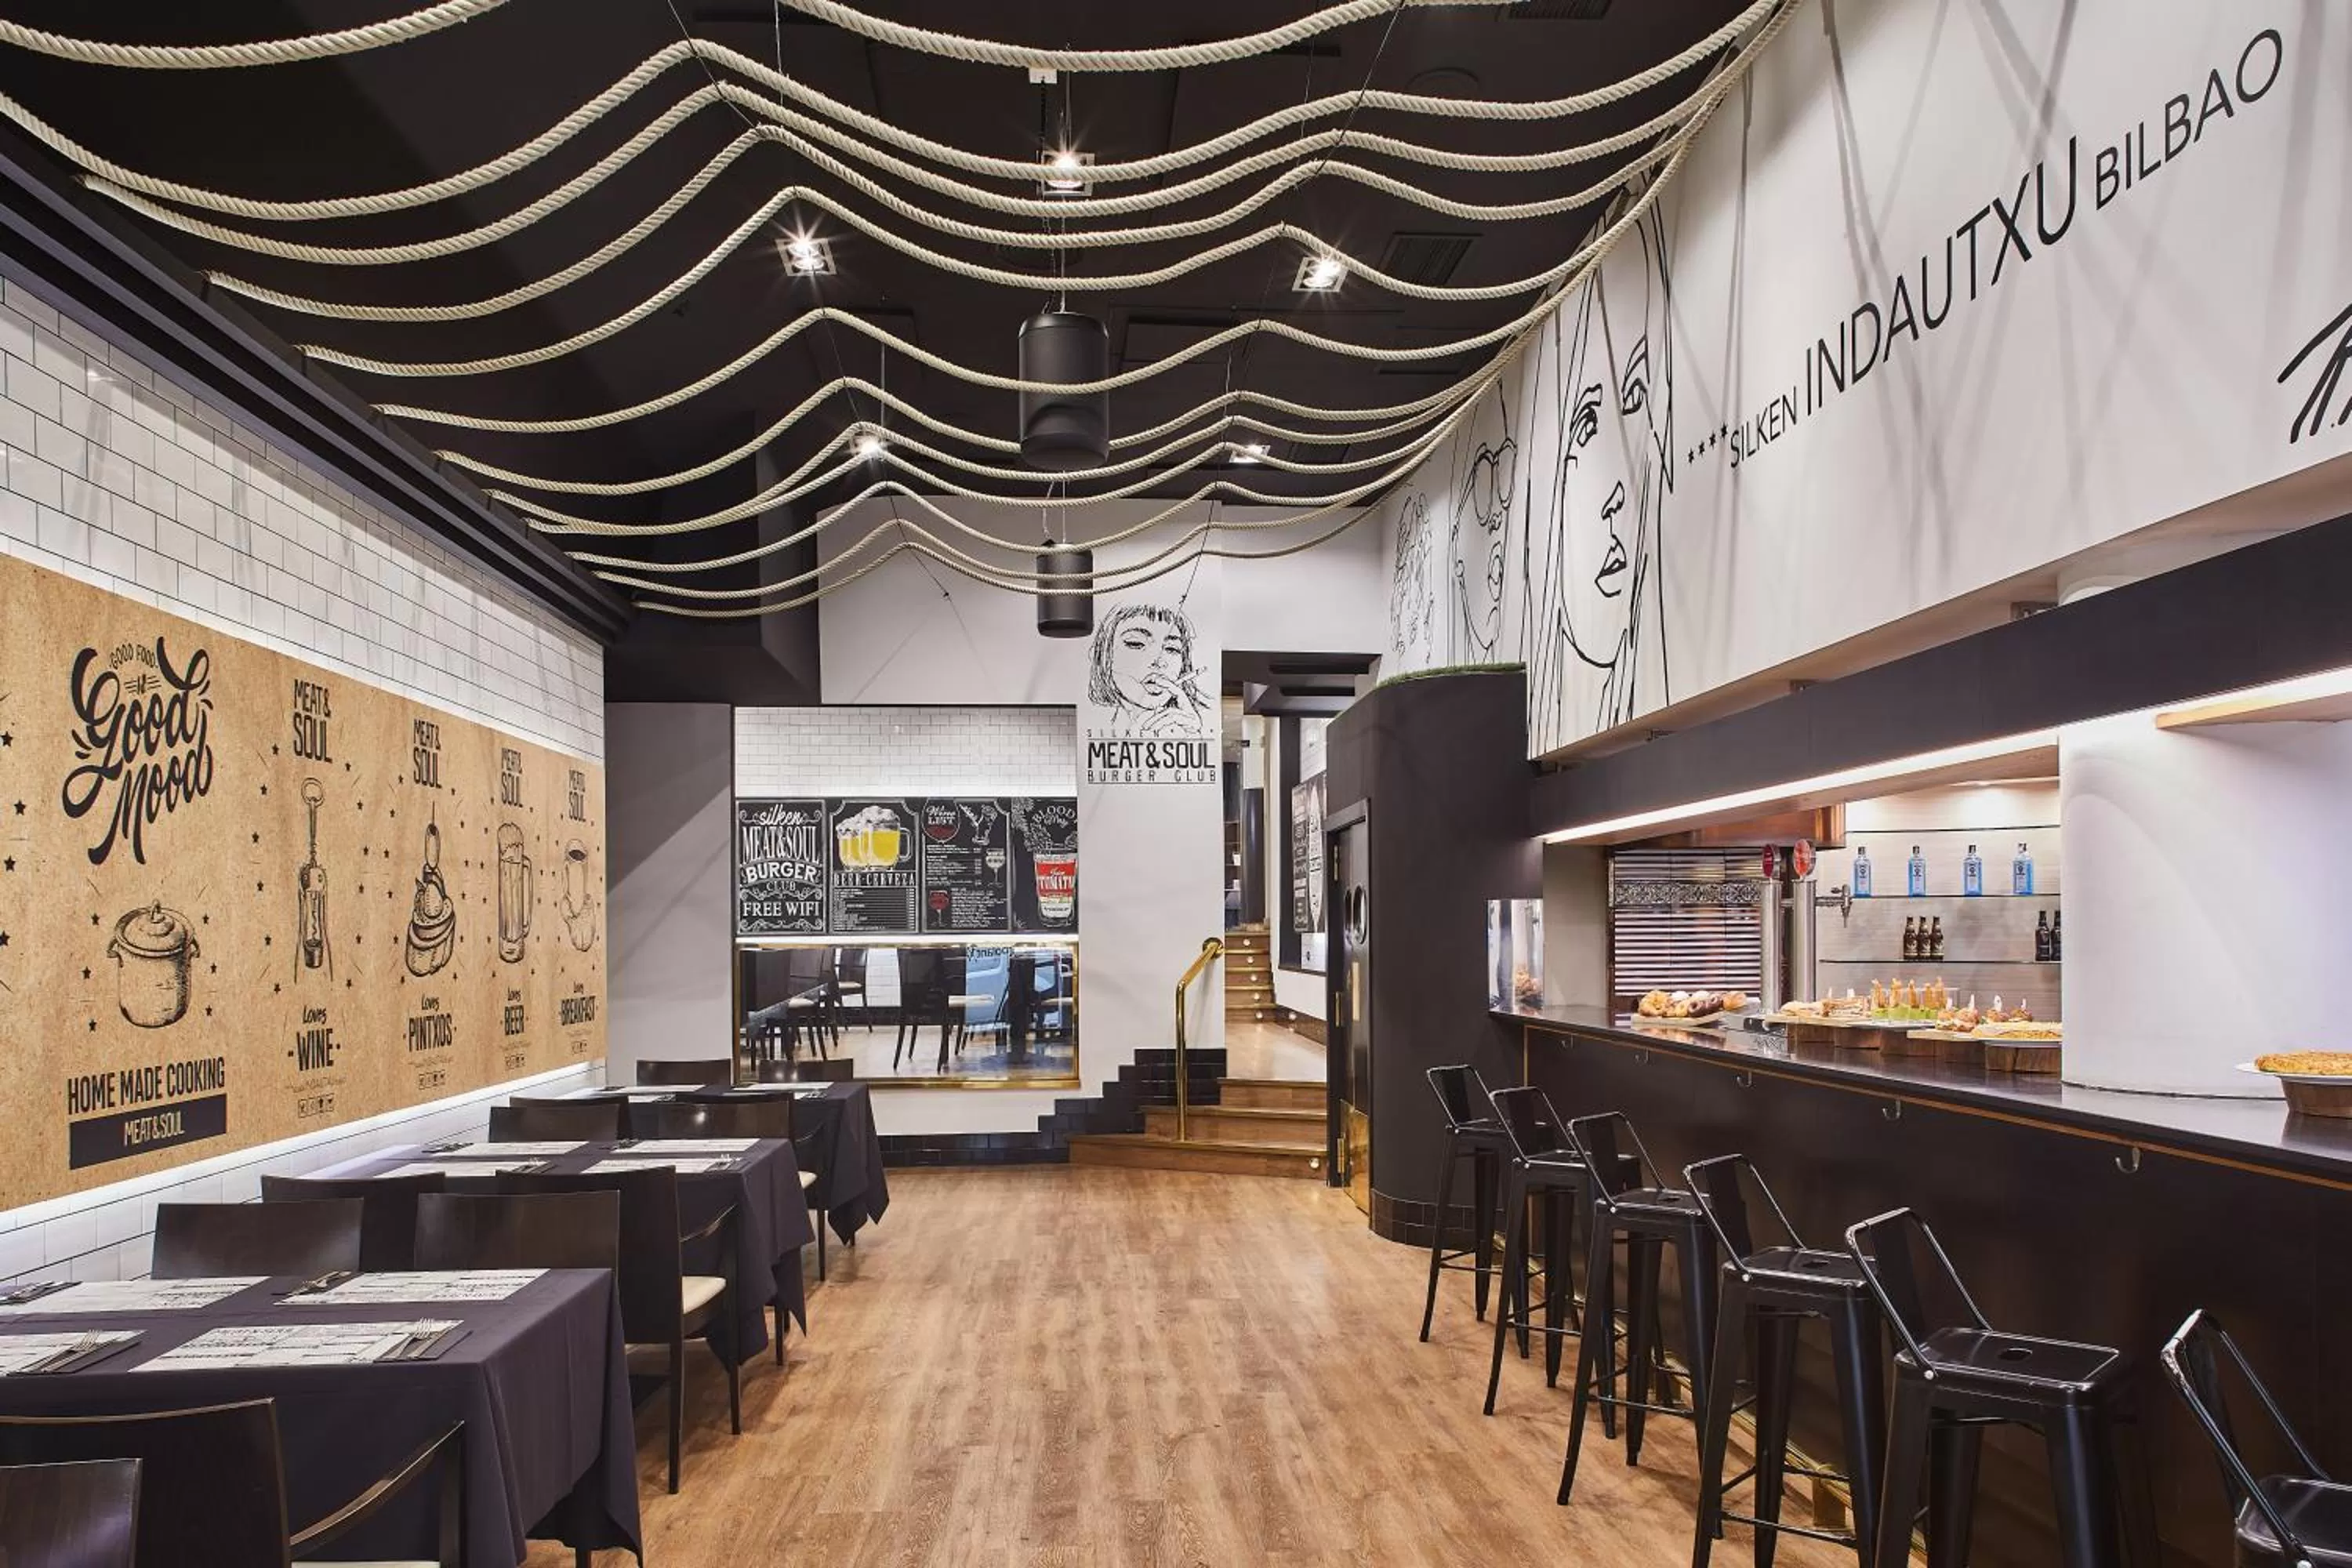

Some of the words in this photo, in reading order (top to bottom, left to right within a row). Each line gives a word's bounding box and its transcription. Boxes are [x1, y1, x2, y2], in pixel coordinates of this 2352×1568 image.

[1730, 386, 1797, 469] SILKEN
[1806, 136, 2077, 417] INDAUTXU
[2096, 28, 2283, 211] BILBAO
[109, 642, 134, 670] GOOD
[136, 644, 156, 669] FOOD
[294, 679, 332, 718] MEAT&
[63, 637, 210, 818] Good
[292, 712, 333, 764] SOUL
[413, 719, 441, 750] MEAT&
[413, 746, 442, 789] SOUL
[1087, 741, 1216, 768] MEAT&SOUL
[88, 710, 213, 864] Mood
[500, 771, 524, 808] SOUL
[1087, 770, 1156, 782] BURGER
[1174, 770, 1216, 782] CLUB
[568, 790, 586, 822] SOUL
[1032, 805, 1076, 823] BLOOD
[742, 826, 820, 865] MEAT&SOUL
[746, 862, 817, 884] BURGER
[743, 902, 782, 916] FREE
[786, 902, 820, 916] WIFI
[408, 1013, 452, 1052] PINTXOS
[504, 1004, 524, 1035] BEER
[296, 1028, 333, 1071] WINE
[67, 1071, 115, 1116] HOME
[120, 1065, 162, 1105] MADE
[166, 1056, 226, 1098] COOKING
[123, 1109, 186, 1147] MEAT&SOUL
